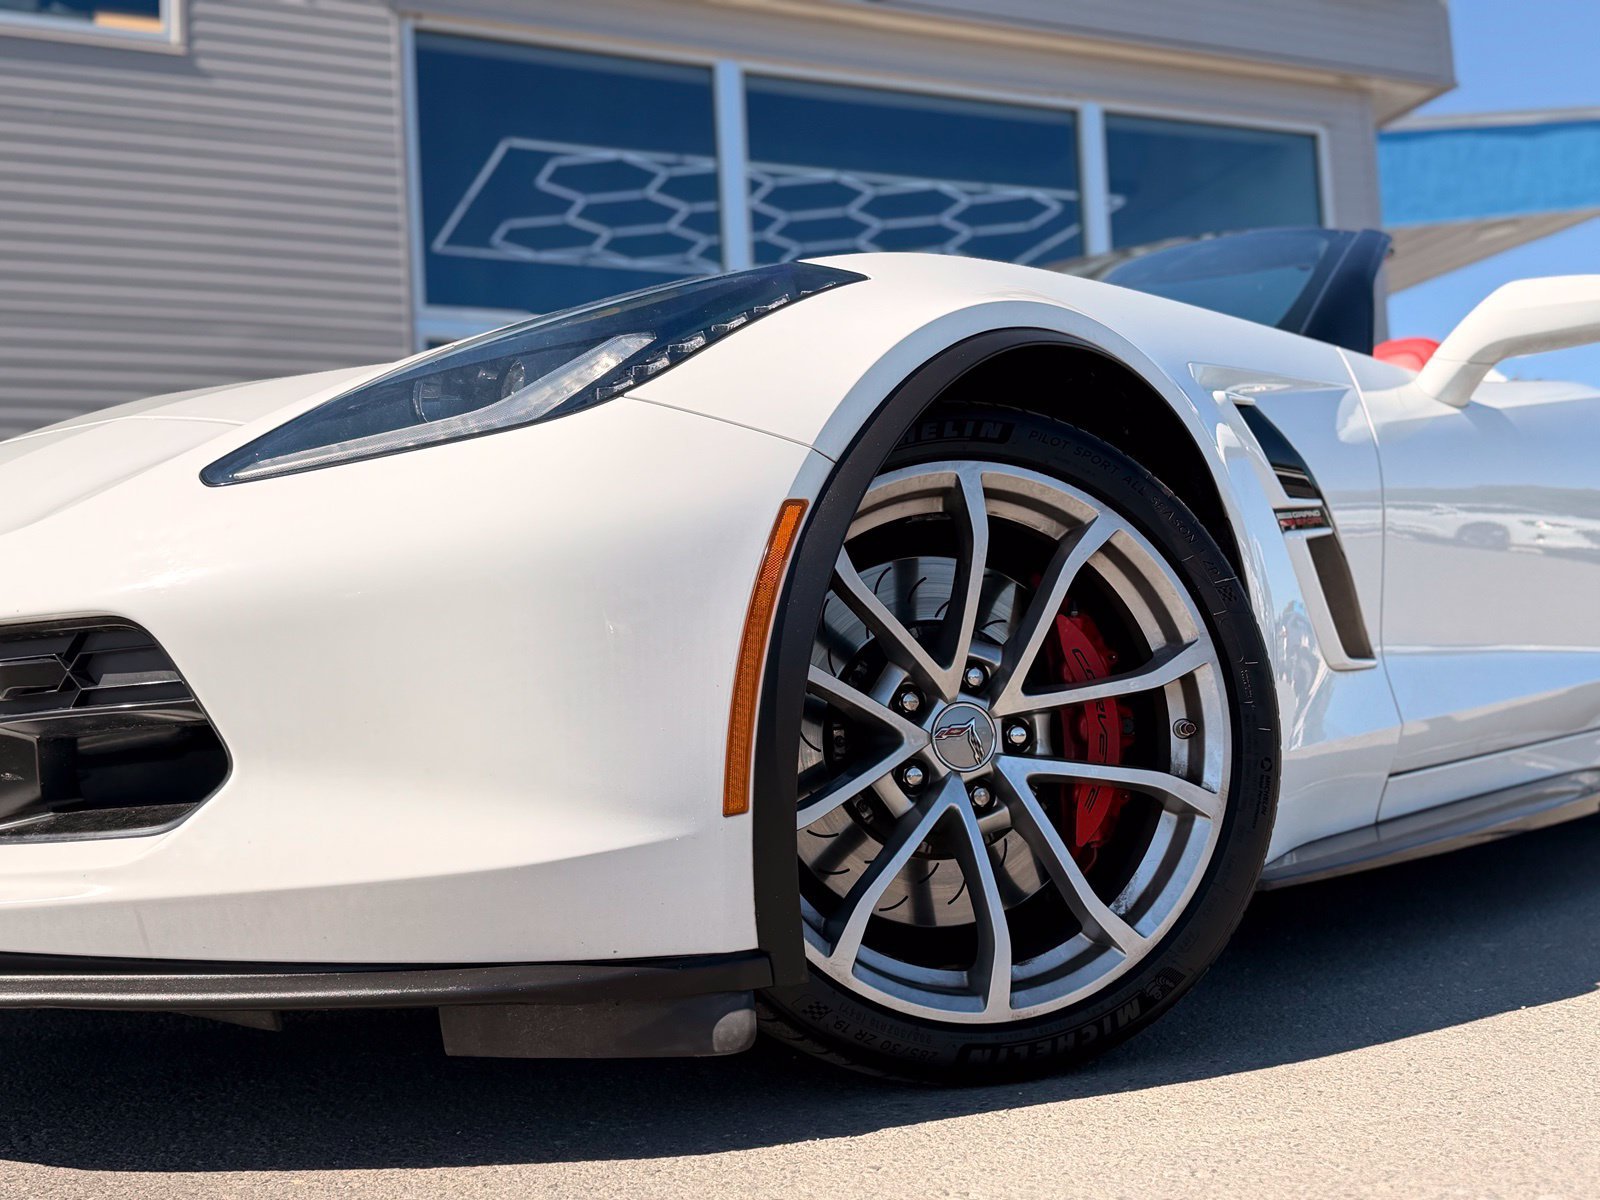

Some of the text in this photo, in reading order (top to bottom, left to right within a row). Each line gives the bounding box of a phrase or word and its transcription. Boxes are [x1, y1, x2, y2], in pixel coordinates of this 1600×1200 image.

[1028, 430, 1070, 449] PILOT
[1073, 446, 1121, 475] SPORT
[1122, 475, 1145, 497] ALL
[1151, 495, 1198, 543] SEASON
[833, 1020, 938, 1062] 285/30 ZR 19
[967, 997, 1142, 1065] MICHELIN
